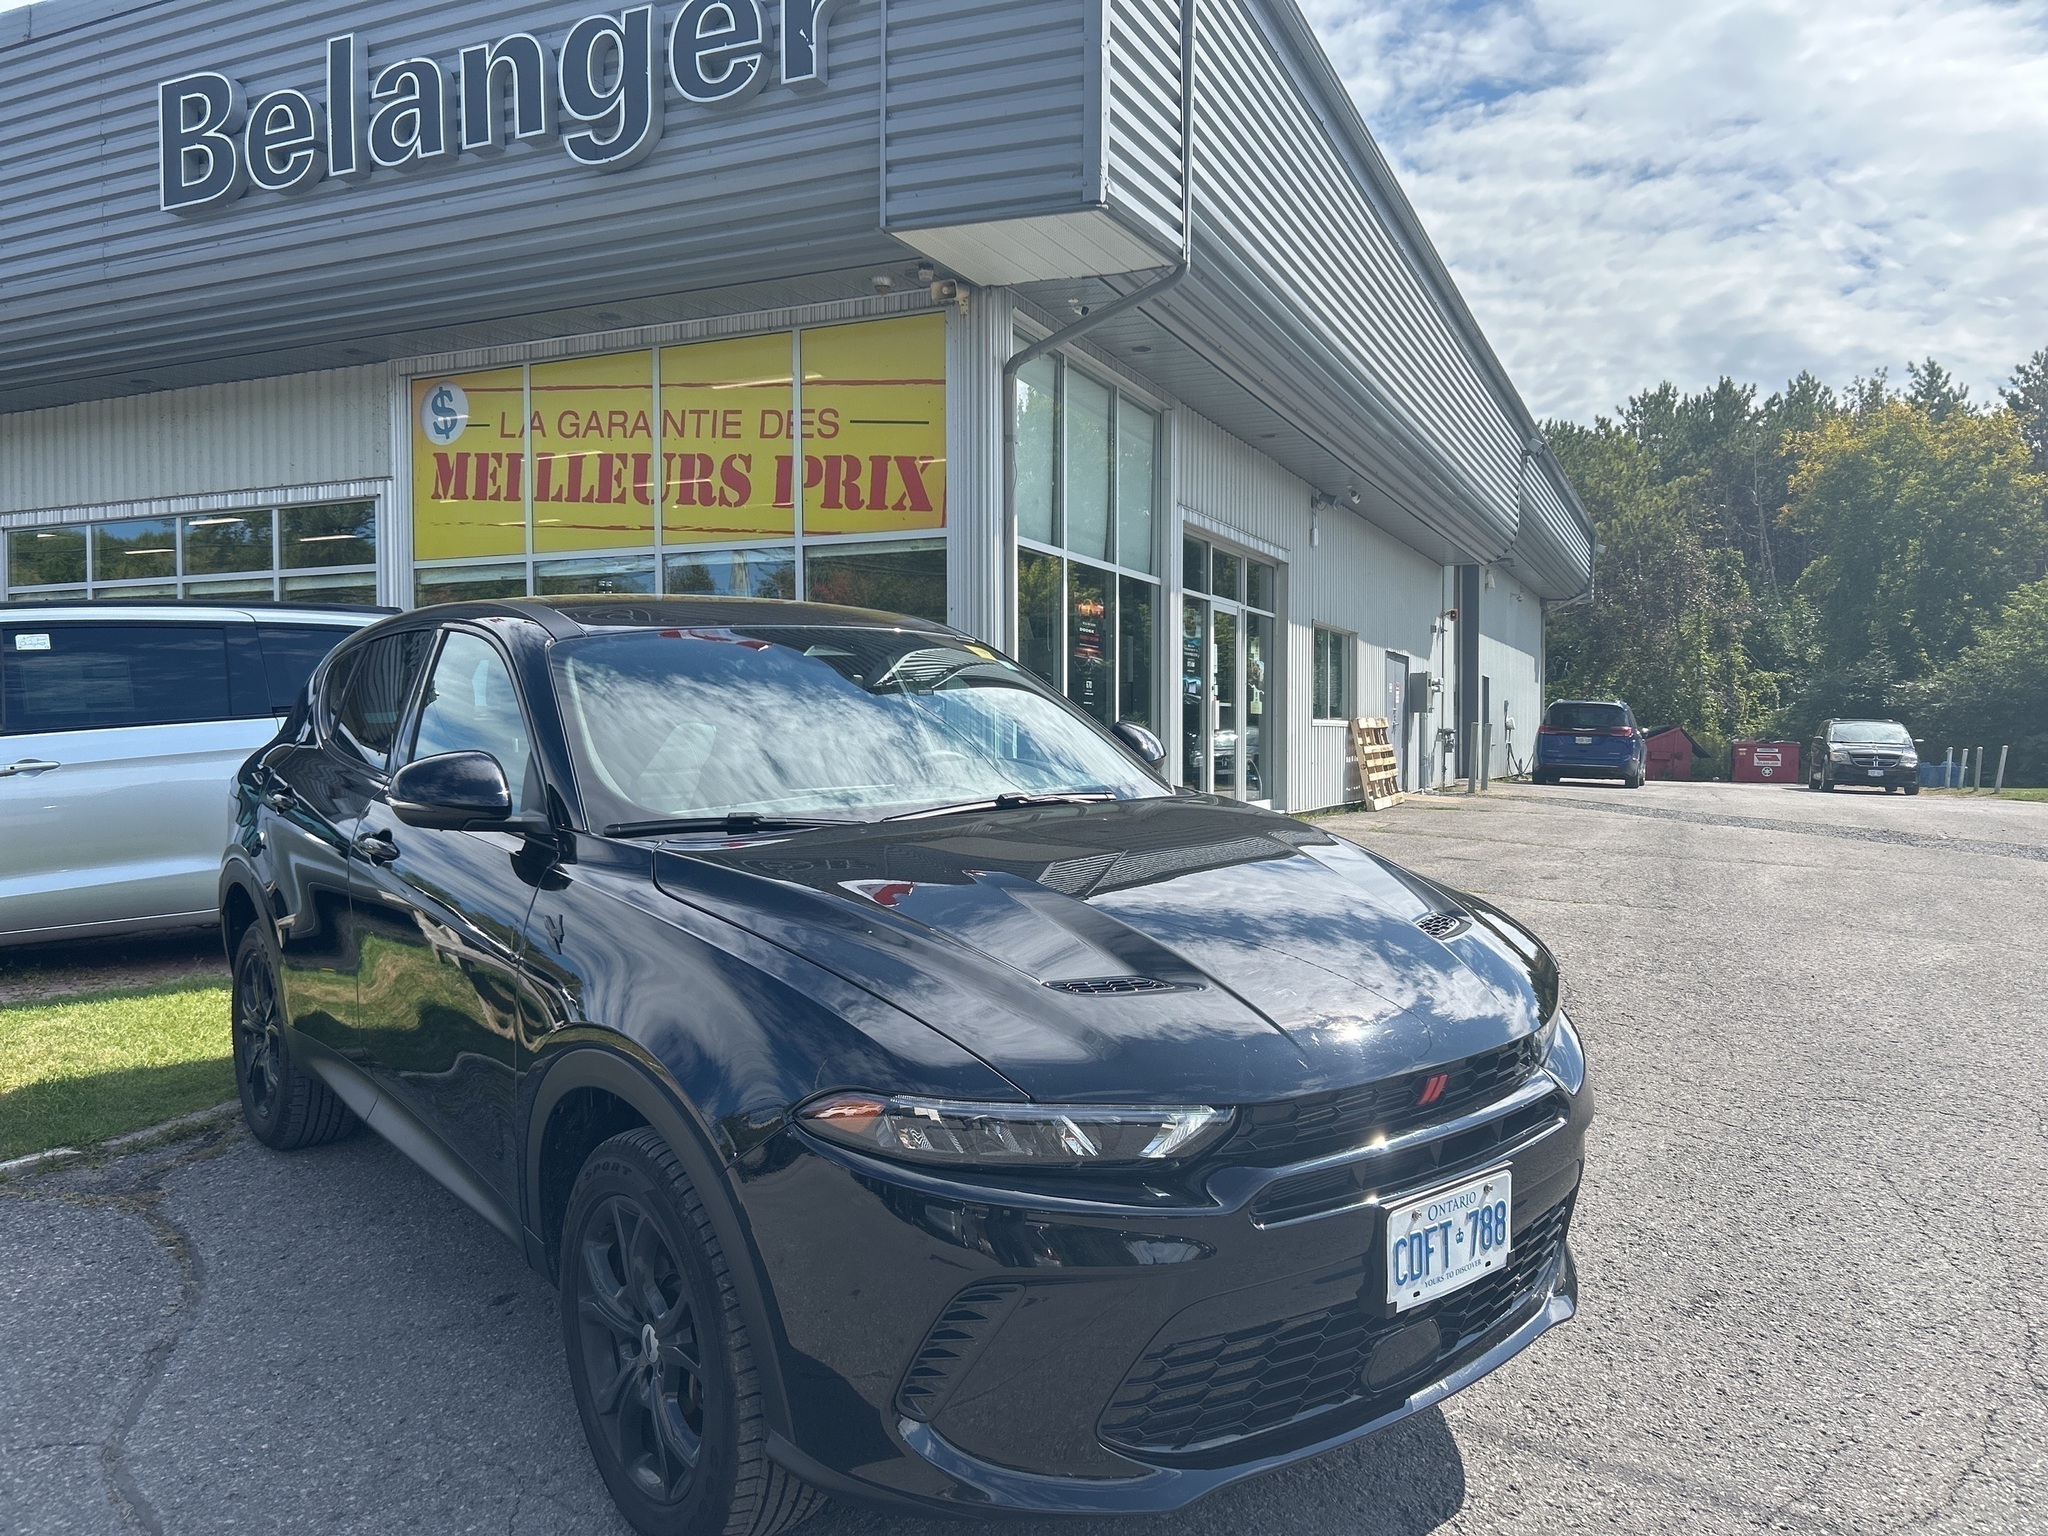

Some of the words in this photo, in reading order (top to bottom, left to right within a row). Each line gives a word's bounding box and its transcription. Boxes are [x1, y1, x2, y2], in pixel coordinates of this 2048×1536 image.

[157, 0, 838, 213] Belanger
[500, 411, 546, 438] LA
[557, 409, 742, 439] GARANTIE
[759, 408, 840, 440] DES
[431, 451, 752, 507] MEILLEURS
[772, 454, 935, 512] PRIX
[584, 1160, 633, 1180] SPORT
[1427, 1191, 1477, 1222] ONTARIO
[1394, 1217, 1453, 1286] CDFT
[1467, 1199, 1508, 1258] 788
[1424, 1275, 1445, 1287] YOURS
[1446, 1271, 1454, 1280] TO
[1455, 1259, 1482, 1276] DISCOVER
